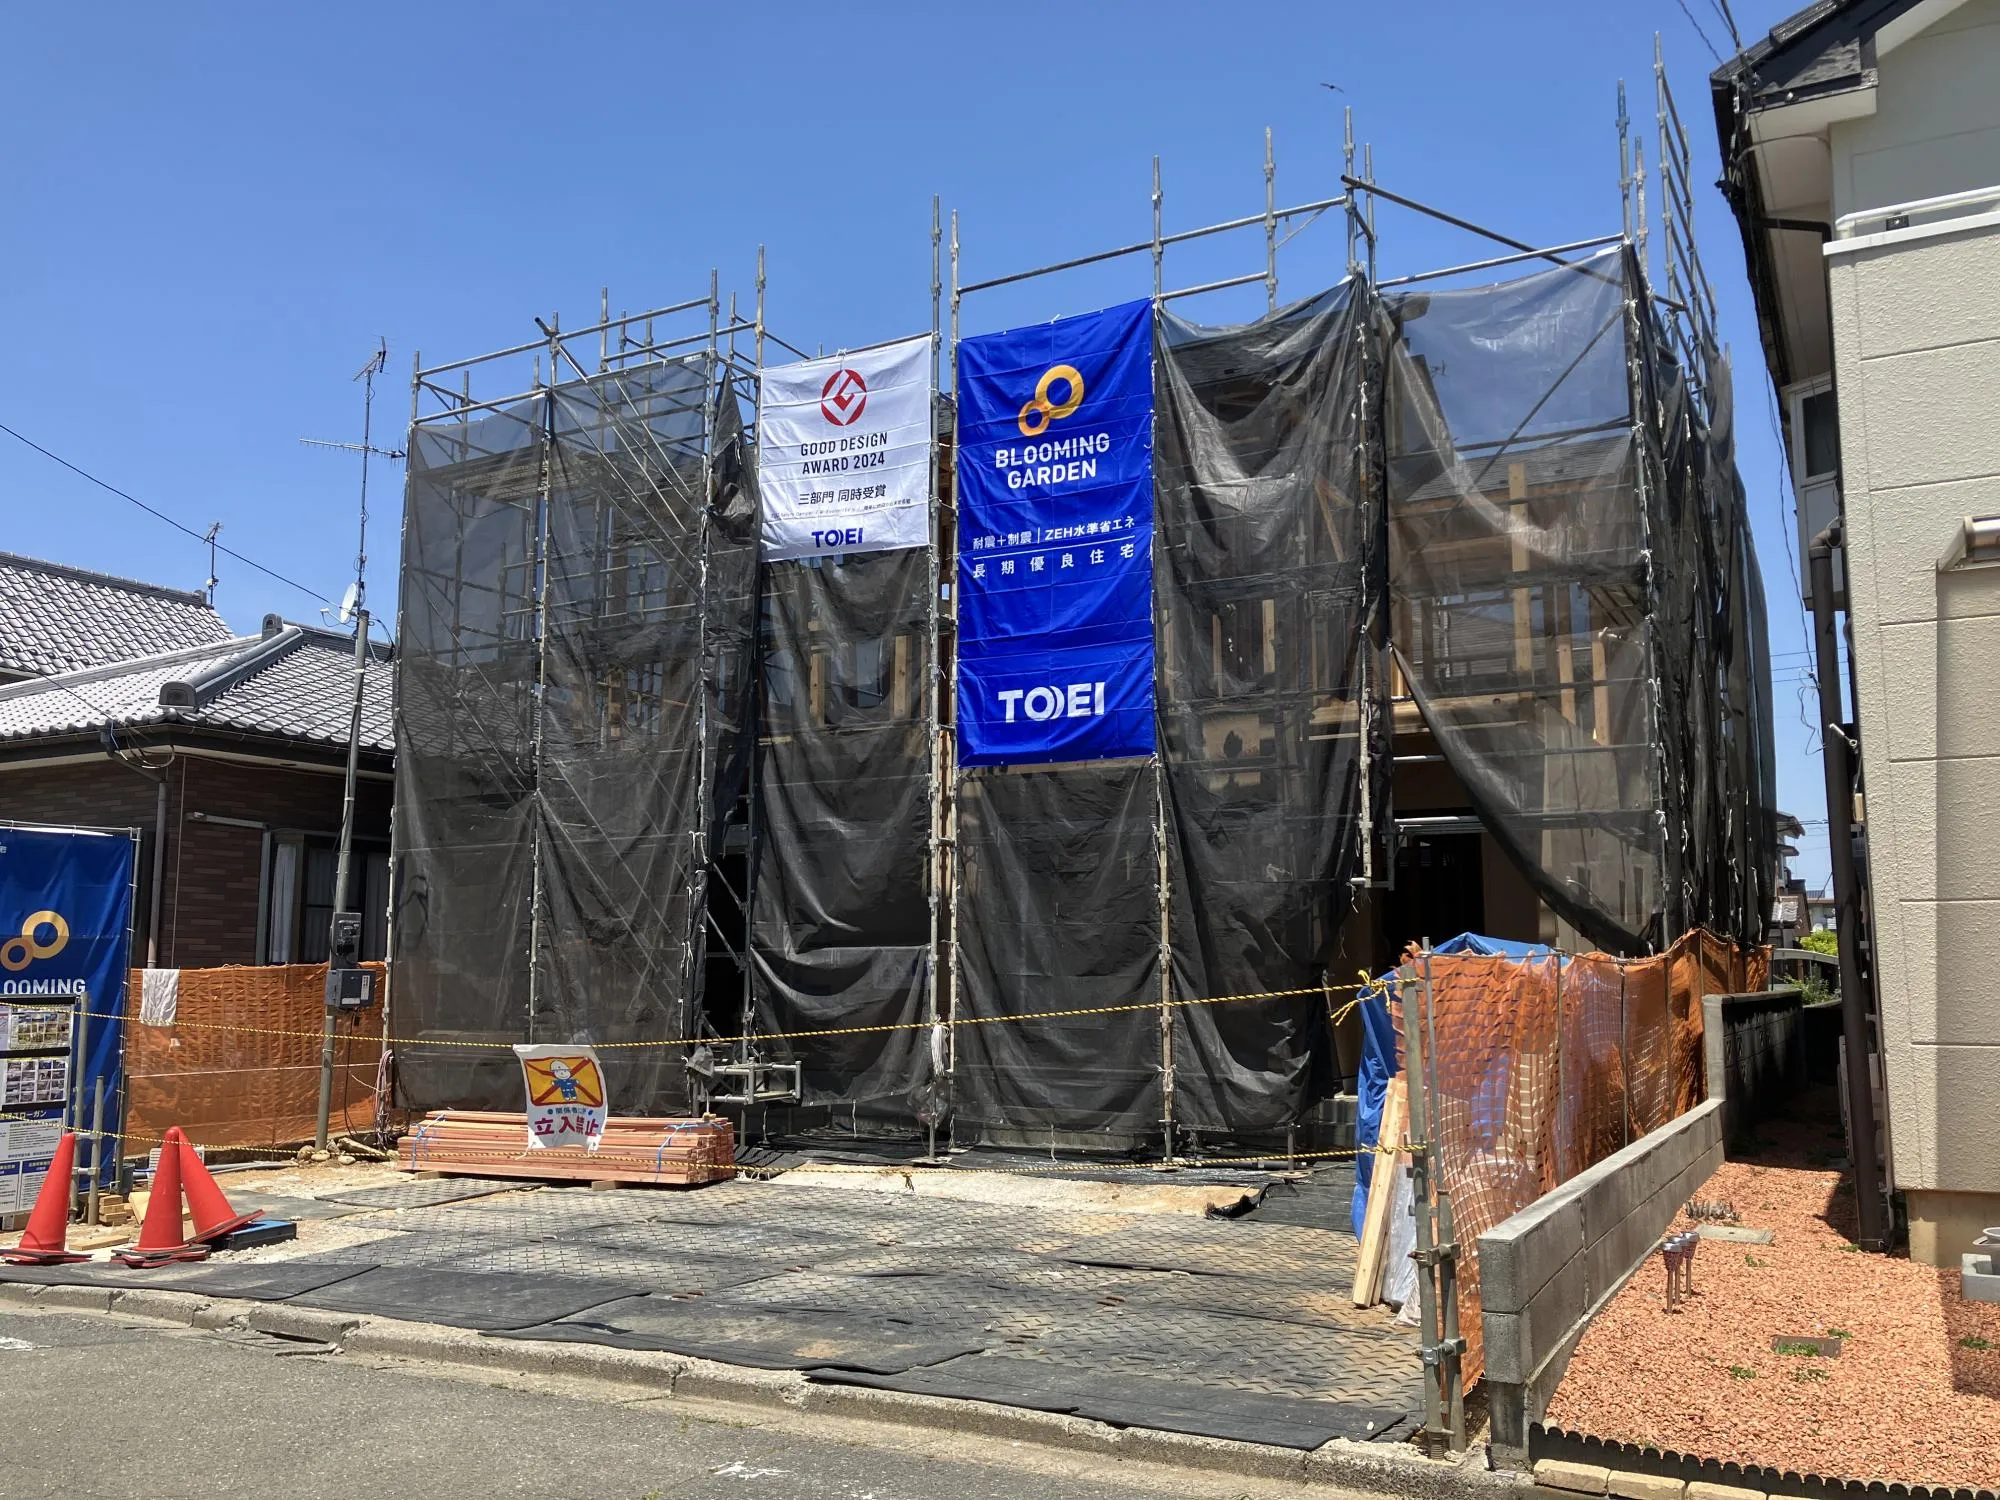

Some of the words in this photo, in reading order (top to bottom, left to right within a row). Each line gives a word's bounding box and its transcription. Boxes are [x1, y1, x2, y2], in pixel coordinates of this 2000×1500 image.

[801, 441, 836, 456] GOOD
[840, 432, 888, 452] DESIGN
[995, 433, 1110, 468] BLOOMING
[802, 457, 849, 475] AWARD
[853, 452, 885, 470] 2024
[1007, 459, 1097, 489] GARDEN
[798, 491, 834, 505] 三部門
[837, 484, 887, 503] 同時受賞
[3, 978, 86, 995] OOMING
